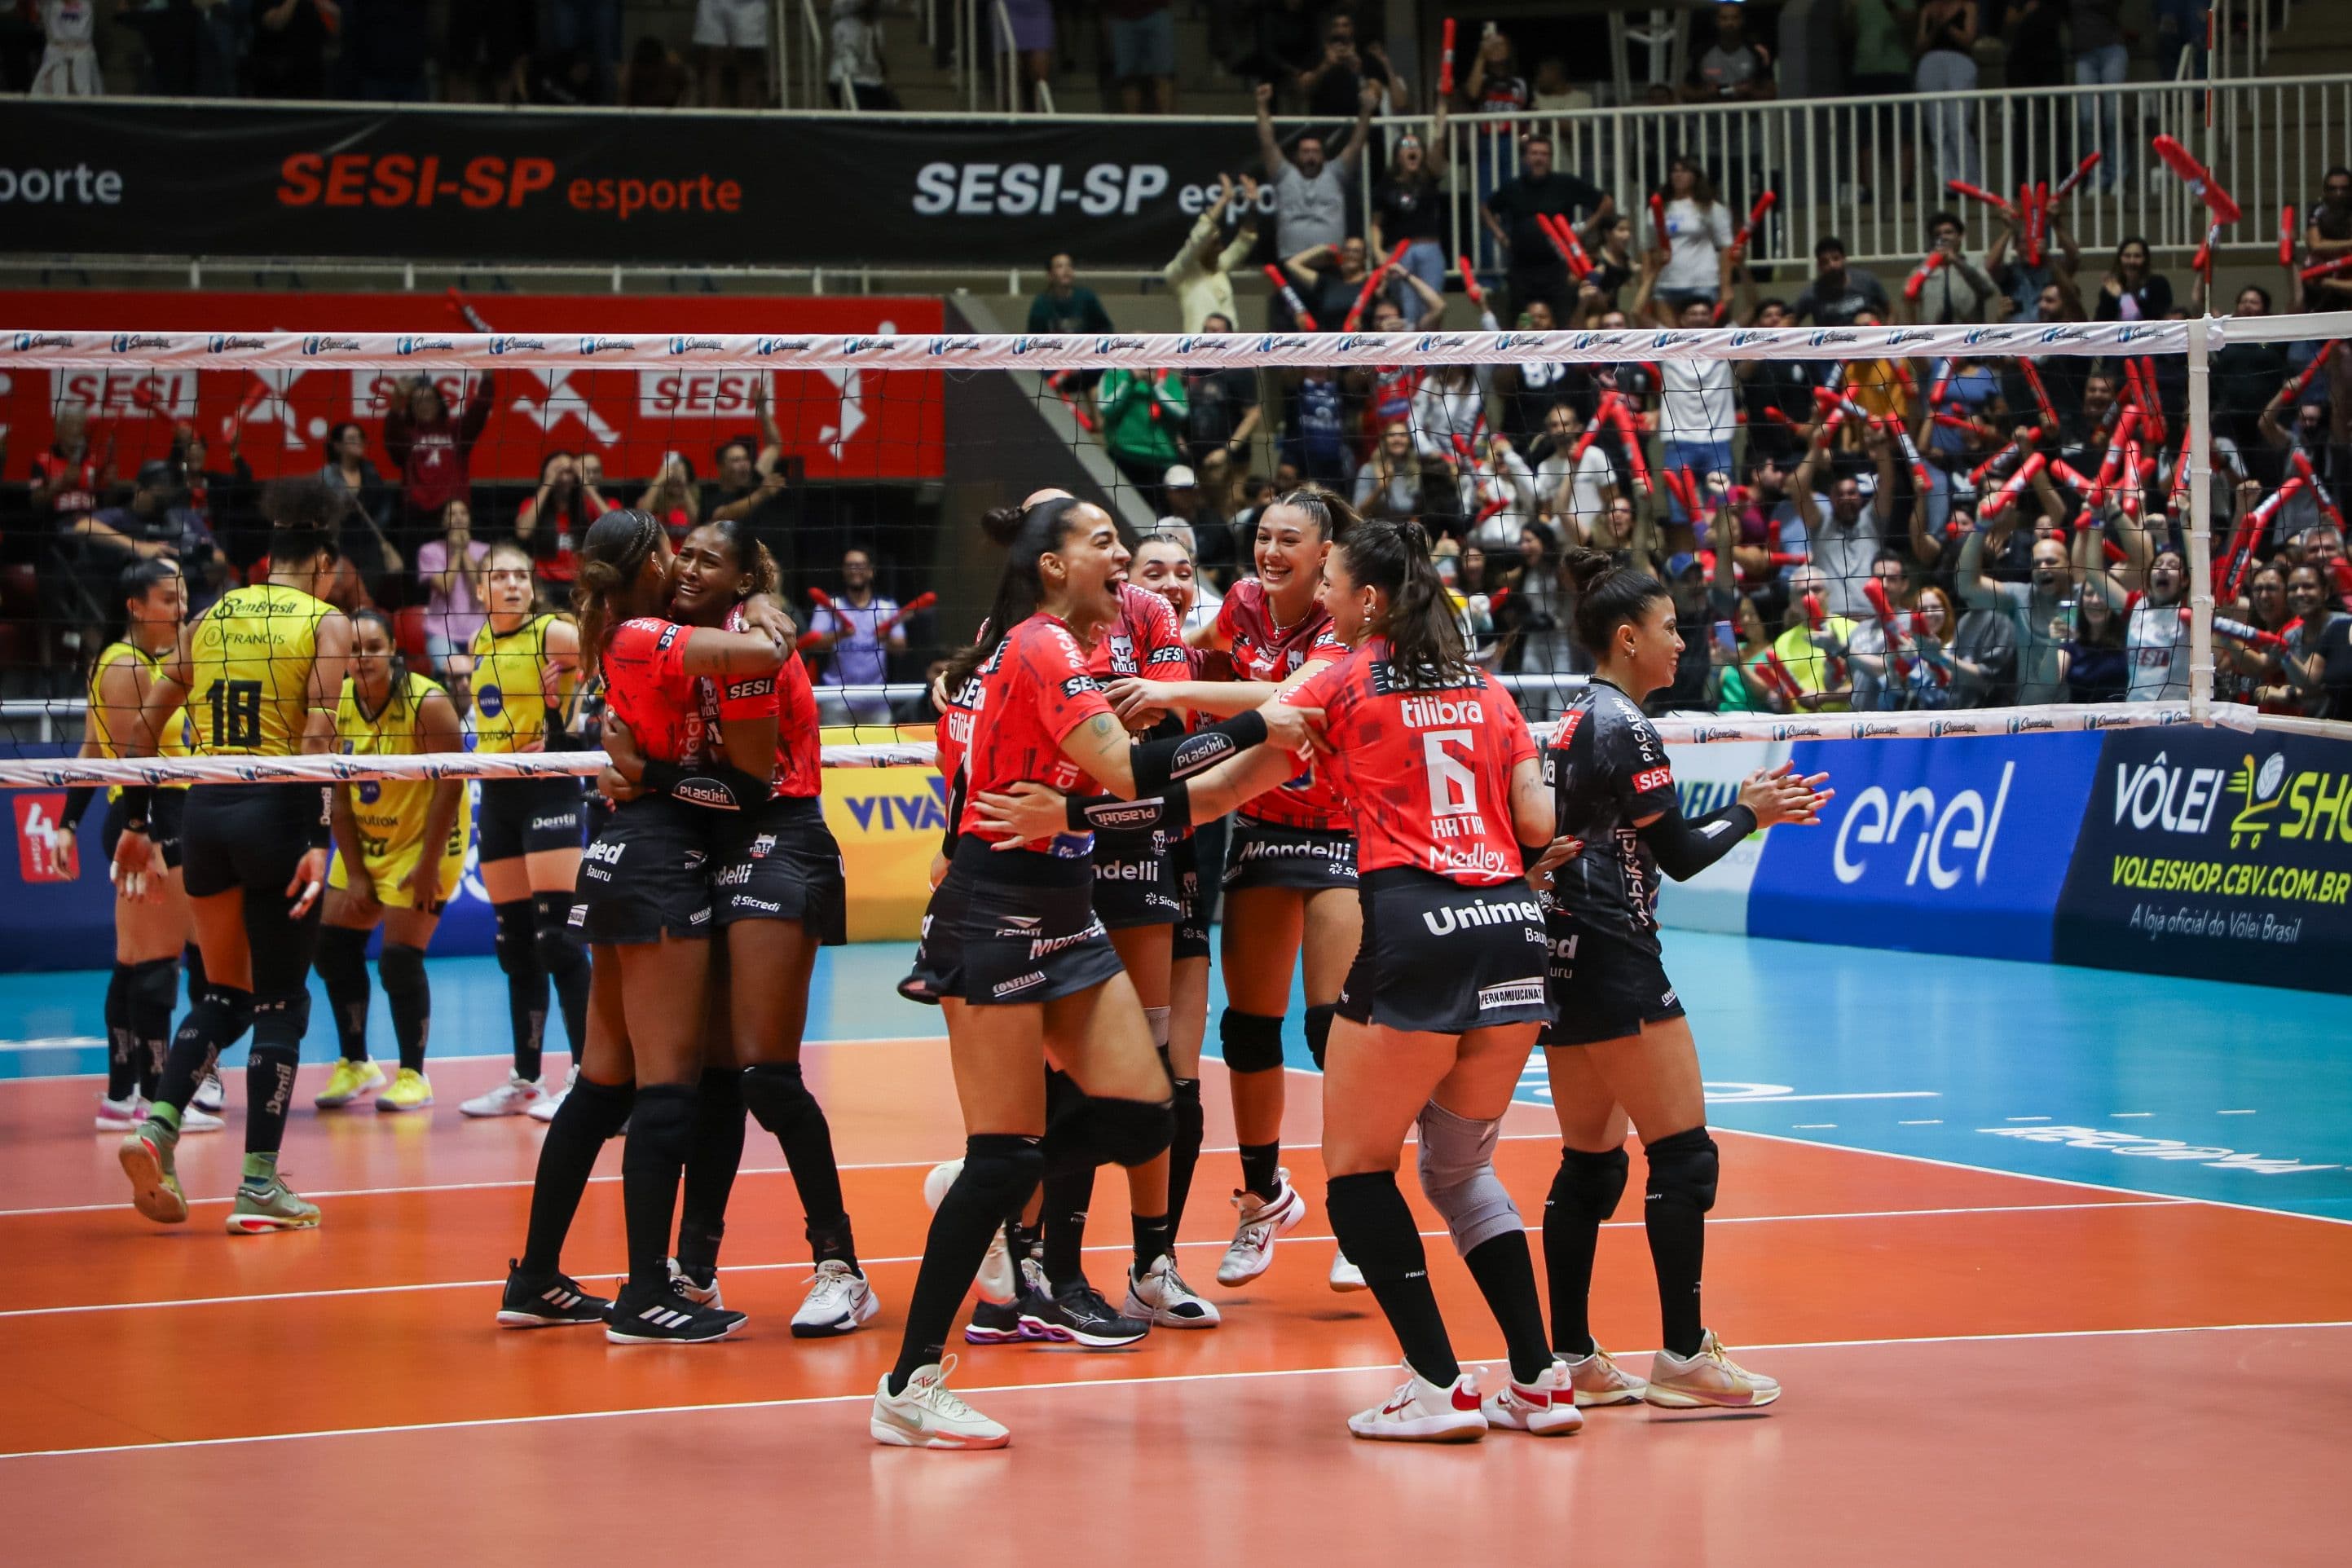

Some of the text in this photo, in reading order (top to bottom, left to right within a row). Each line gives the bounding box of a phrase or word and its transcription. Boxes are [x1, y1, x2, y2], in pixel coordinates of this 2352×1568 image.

[277, 154, 742, 221] SESI-SP esporte
[913, 163, 1169, 215] SESI-SP
[66, 375, 183, 410] SESI
[365, 376, 479, 411] SSI
[653, 377, 761, 411] SESI
[226, 633, 284, 645] FRANCIS
[1152, 647, 1184, 663] SESI
[480, 697, 500, 707] NIVEA
[729, 679, 771, 699] SESI
[206, 678, 262, 747] 18
[1400, 696, 1484, 728] tilibra
[1177, 736, 1227, 767] Plasútil
[1423, 729, 1478, 816] 6
[680, 786, 729, 804] Plasútil
[2115, 751, 2226, 833] VÔLEI
[532, 813, 576, 830] Dentil
[1430, 816, 1486, 839] KATIA
[1833, 760, 2015, 890] enel
[1239, 841, 1351, 861] Mondelli
[2112, 855, 2351, 904] VOLEISHOP.CBV.COM.BR
[740, 896, 781, 913] Sicredi
[2130, 904, 2302, 943] A loja oficial do Vôlei Brasil
